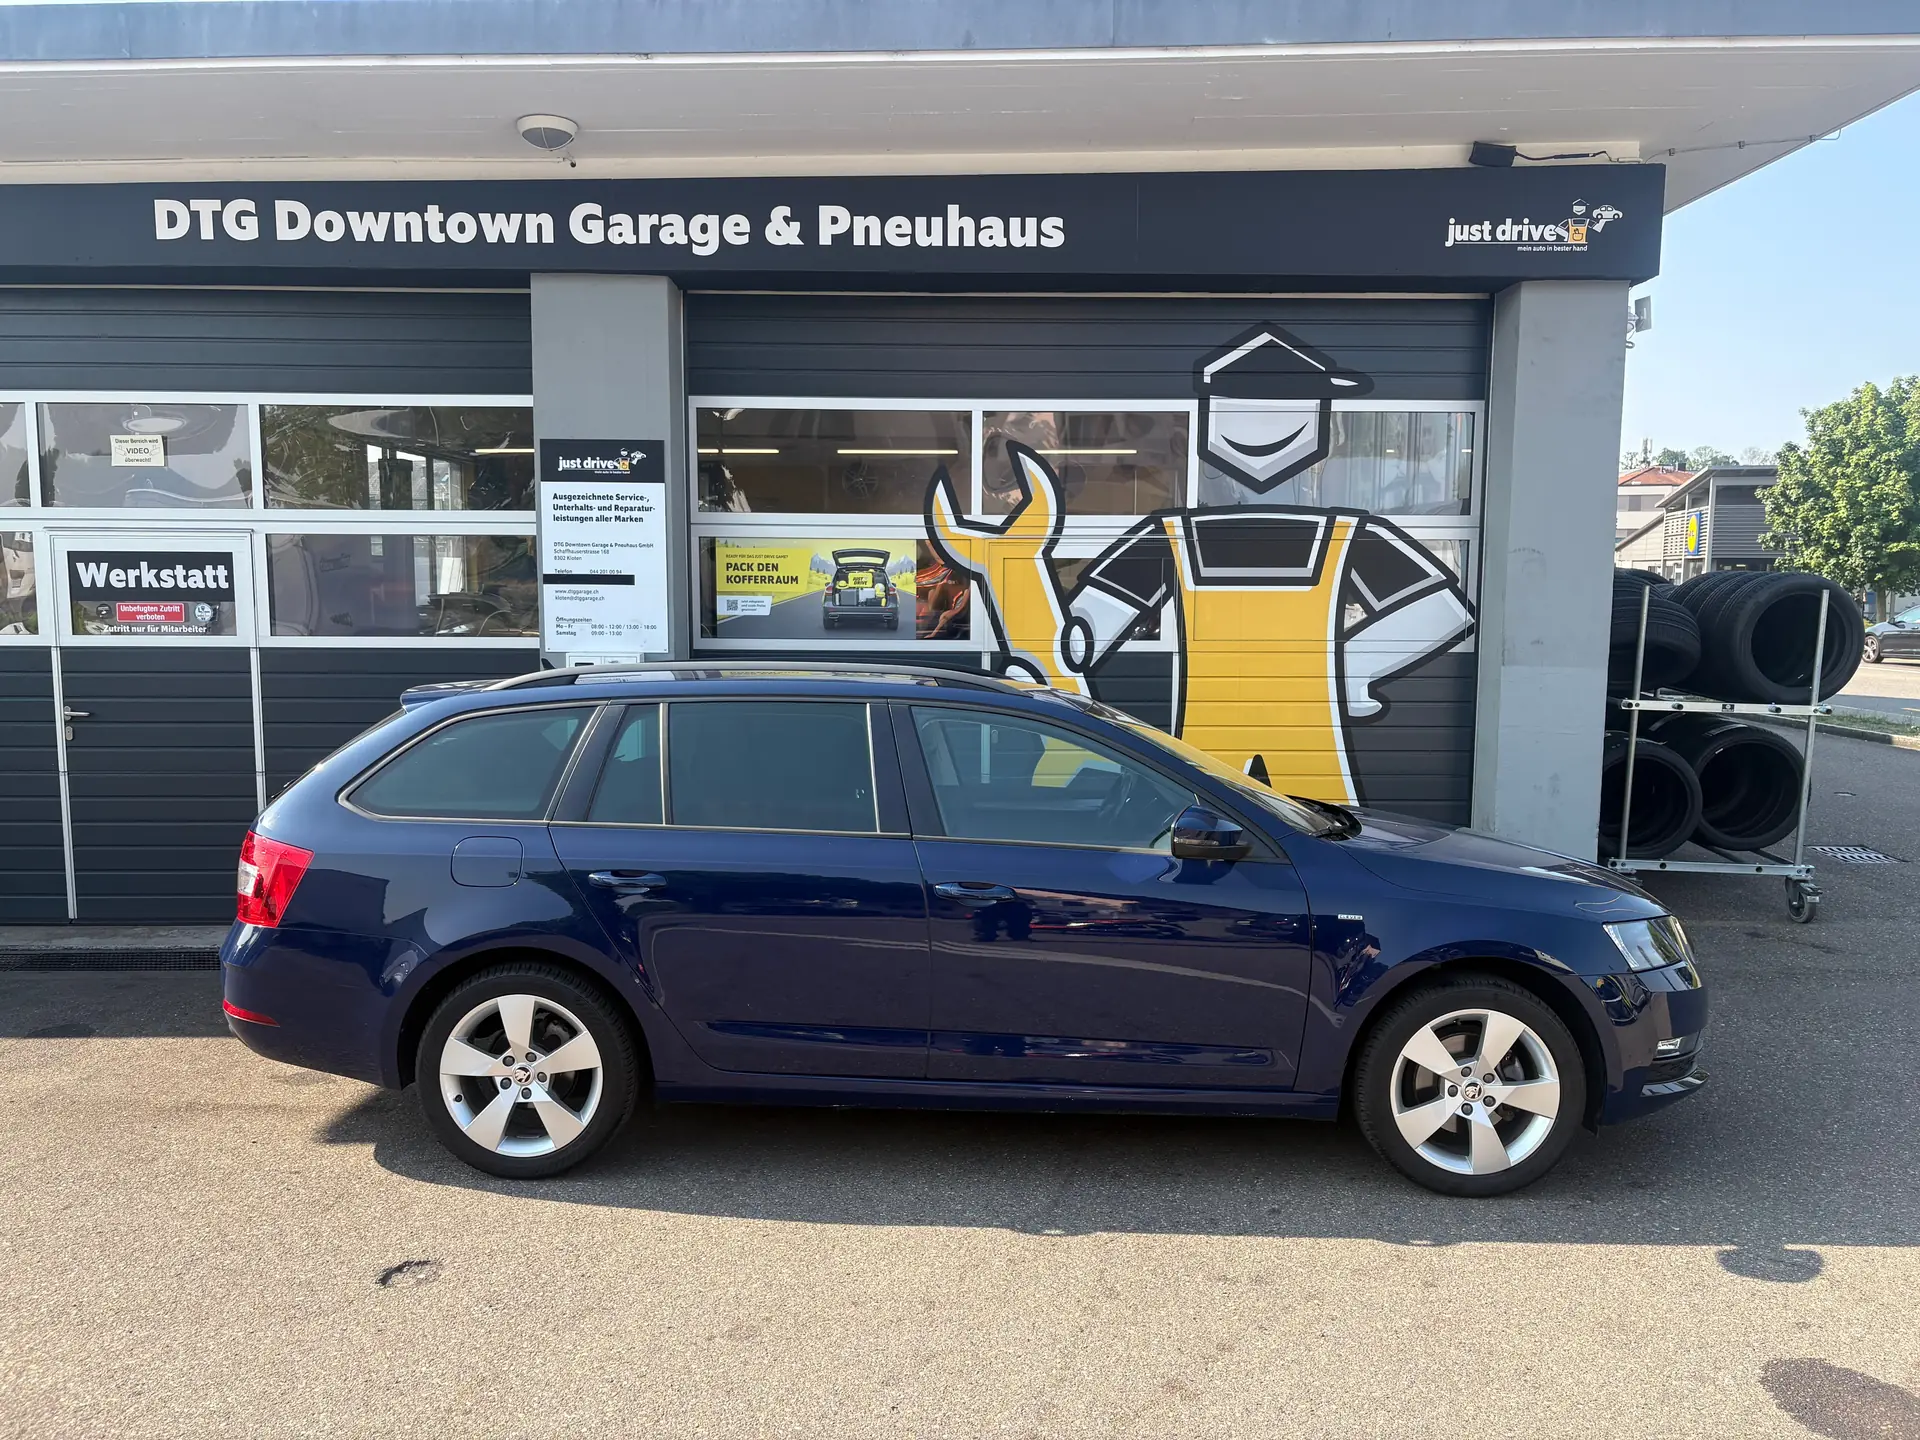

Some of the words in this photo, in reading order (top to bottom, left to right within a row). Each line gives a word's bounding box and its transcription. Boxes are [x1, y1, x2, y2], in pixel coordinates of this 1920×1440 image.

[154, 198, 260, 241] DTG
[275, 200, 555, 244] Downtown
[569, 202, 751, 256] Garage
[764, 205, 805, 247] &
[818, 204, 1065, 249] Pneuhaus
[1445, 218, 1492, 247] just
[1496, 218, 1557, 241] drive
[126, 447, 150, 455] VIDEO
[558, 456, 582, 471] just
[583, 456, 615, 469] drive
[553, 493, 614, 502] Ausgezeichnete
[615, 494, 650, 503] Service-,
[597, 504, 613, 512] und
[614, 504, 656, 513] Reparatur-
[553, 514, 594, 524] leistungen
[614, 515, 644, 523] Marken
[726, 562, 755, 572] PACK
[757, 562, 779, 572] DEN
[75, 561, 230, 589] Werkstatt
[726, 574, 799, 585] KOFFERRAUM
[120, 605, 159, 614] Unbefugten
[159, 605, 181, 613] Zutritt
[135, 613, 166, 621] verboten
[103, 624, 130, 633] Zutritt
[131, 625, 146, 633] nur
[147, 625, 159, 633] für
[160, 625, 207, 633] Mitarbeiter
